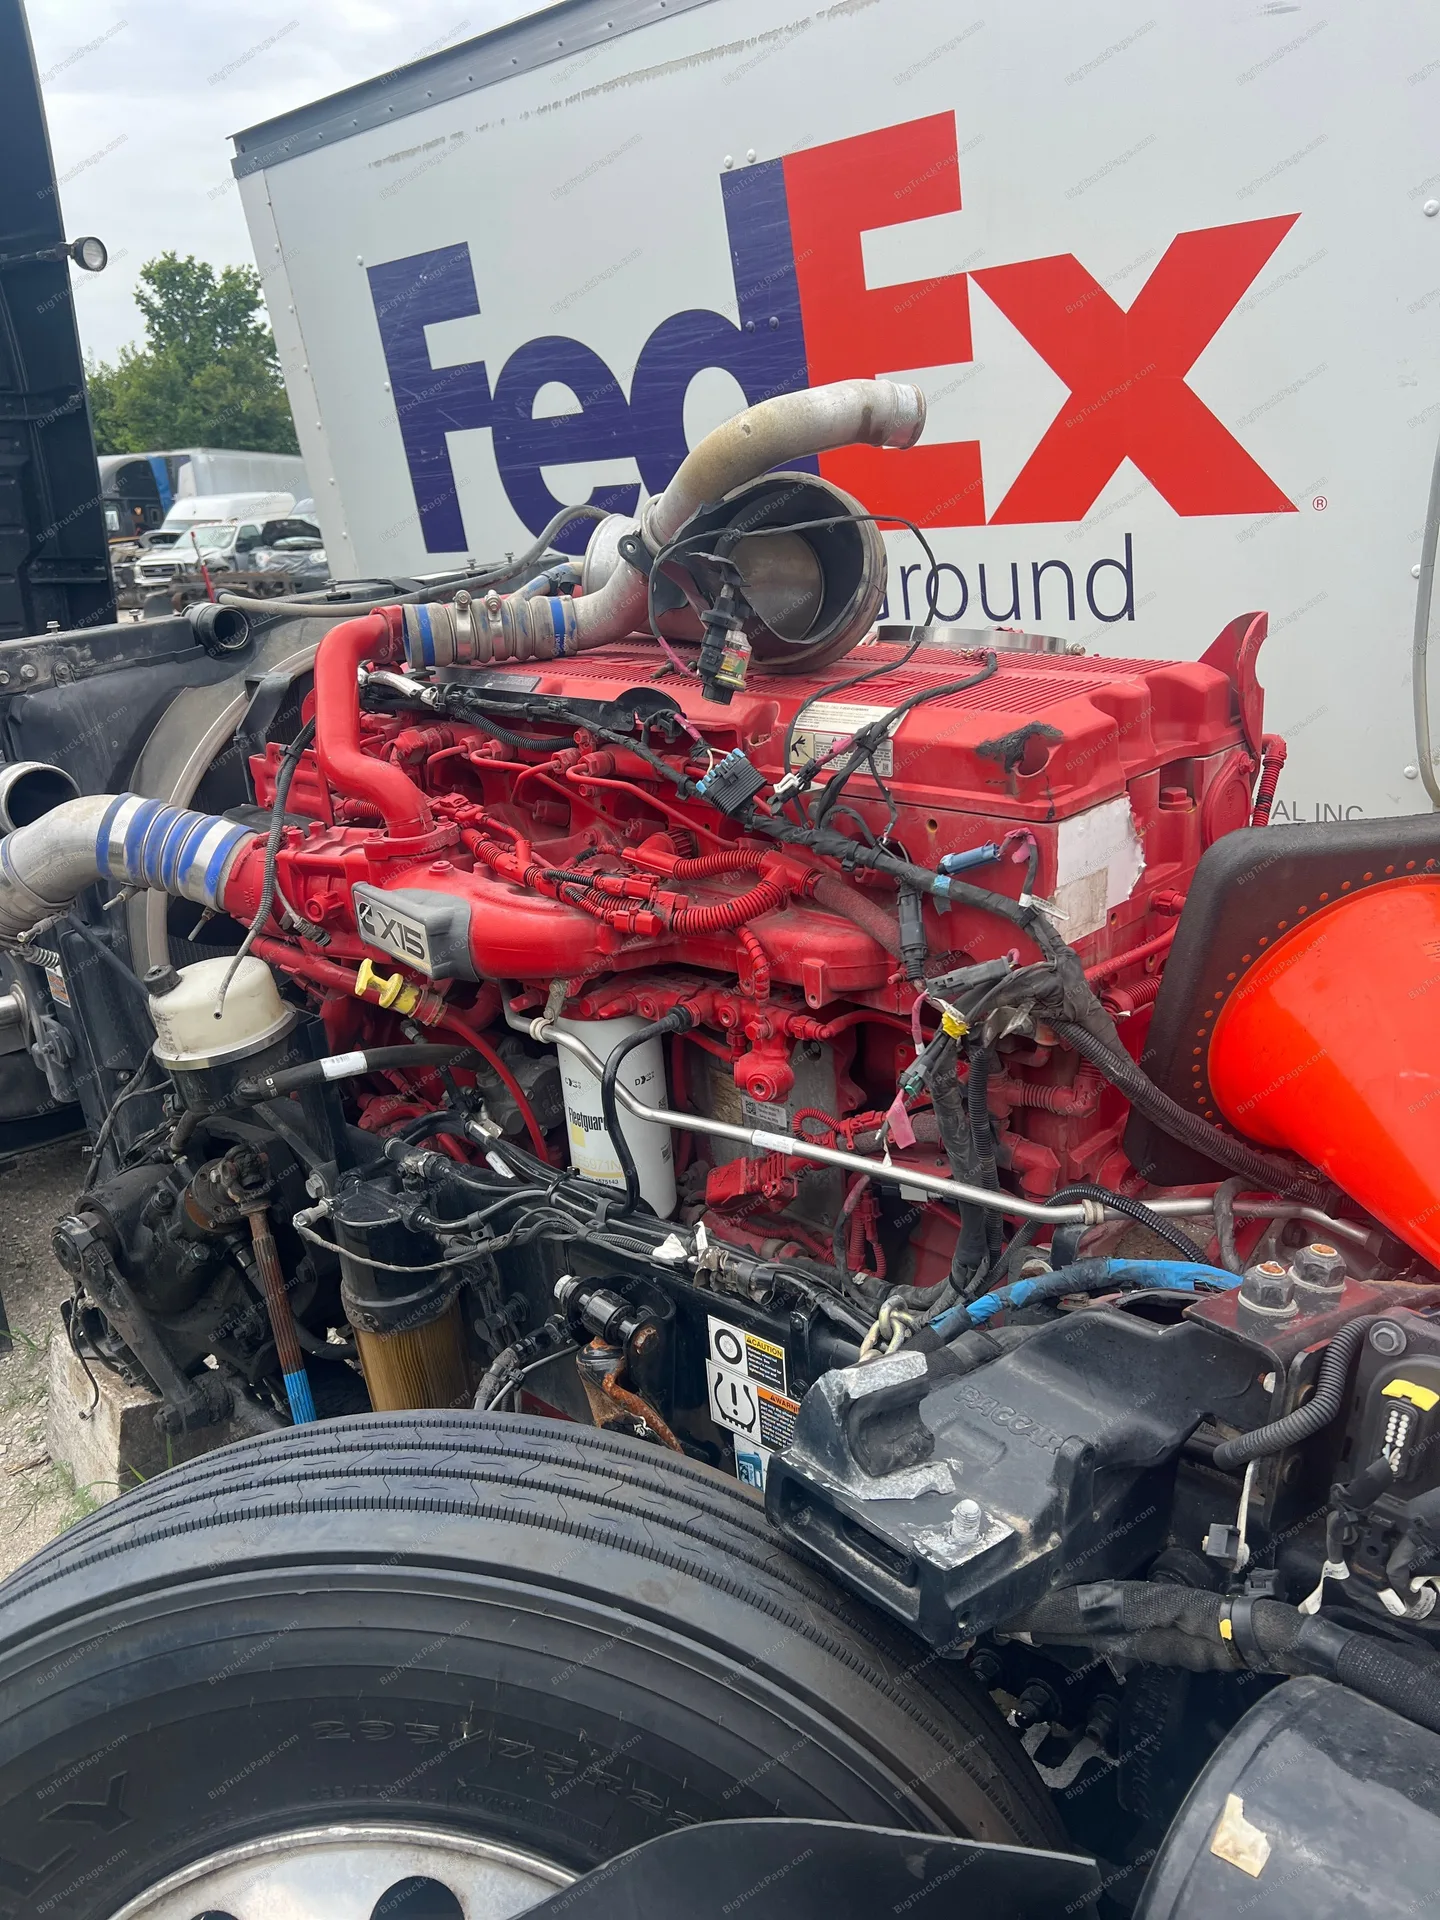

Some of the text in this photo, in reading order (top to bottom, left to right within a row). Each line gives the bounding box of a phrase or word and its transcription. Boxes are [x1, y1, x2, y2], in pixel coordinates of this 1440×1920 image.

[366, 109, 1302, 556] FedEx
[875, 533, 1135, 622] round
[377, 911, 425, 960] X15
[751, 1339, 782, 1358] CAUTION
